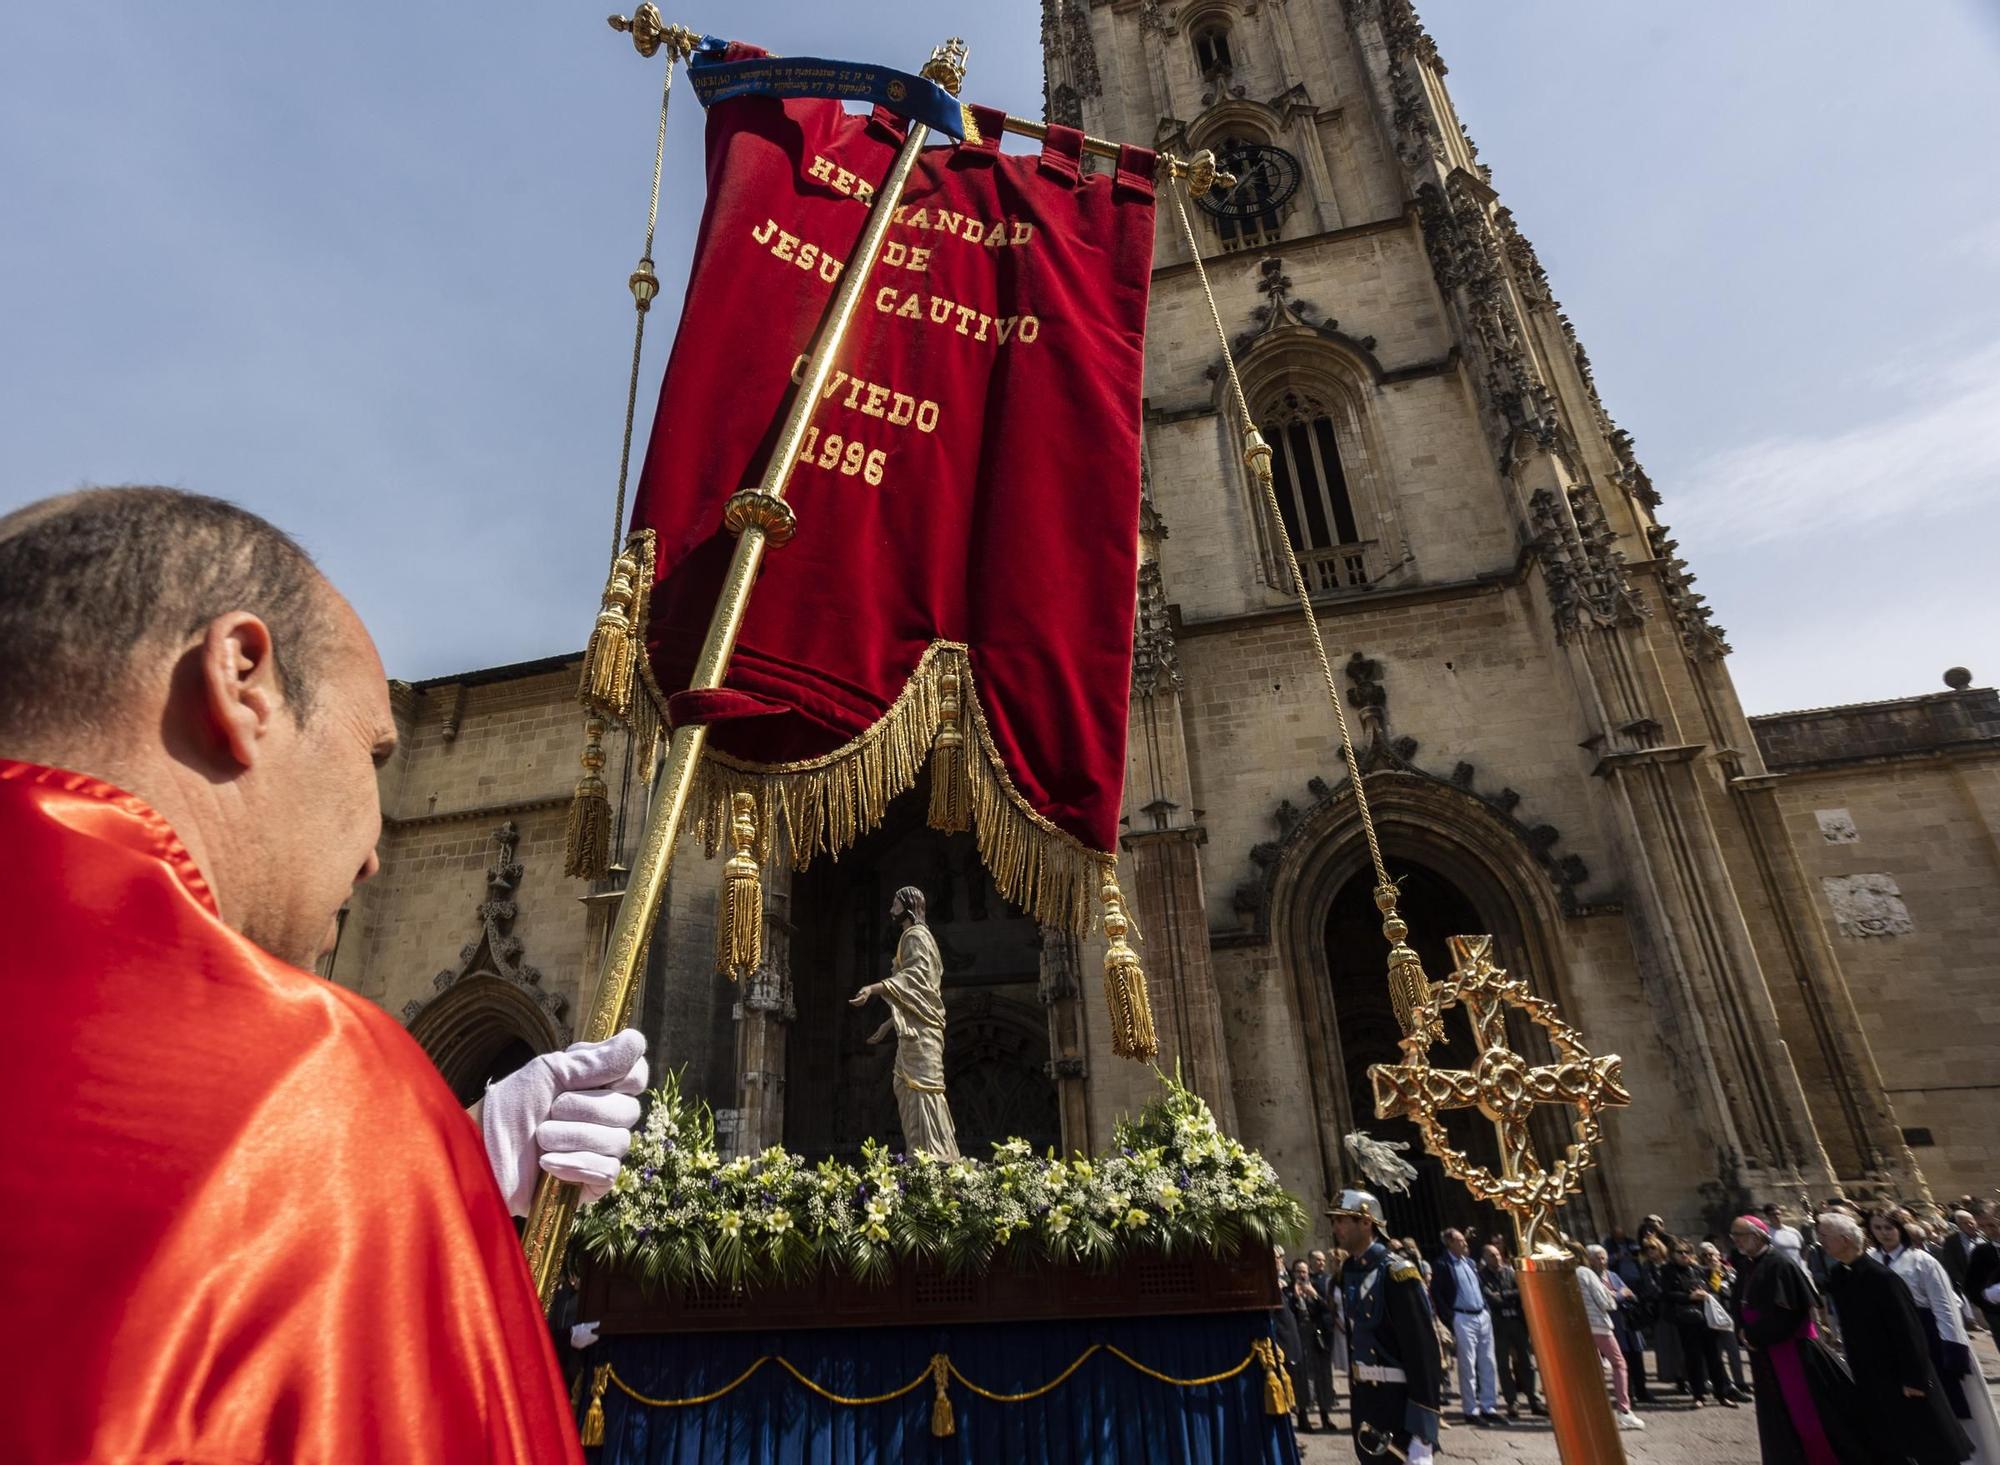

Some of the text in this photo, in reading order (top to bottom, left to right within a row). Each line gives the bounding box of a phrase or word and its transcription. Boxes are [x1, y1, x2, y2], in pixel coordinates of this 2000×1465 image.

[751, 218, 931, 284] JESU DE
[875, 286, 1040, 345] CAUTIVO
[800, 426, 887, 486] 1996
